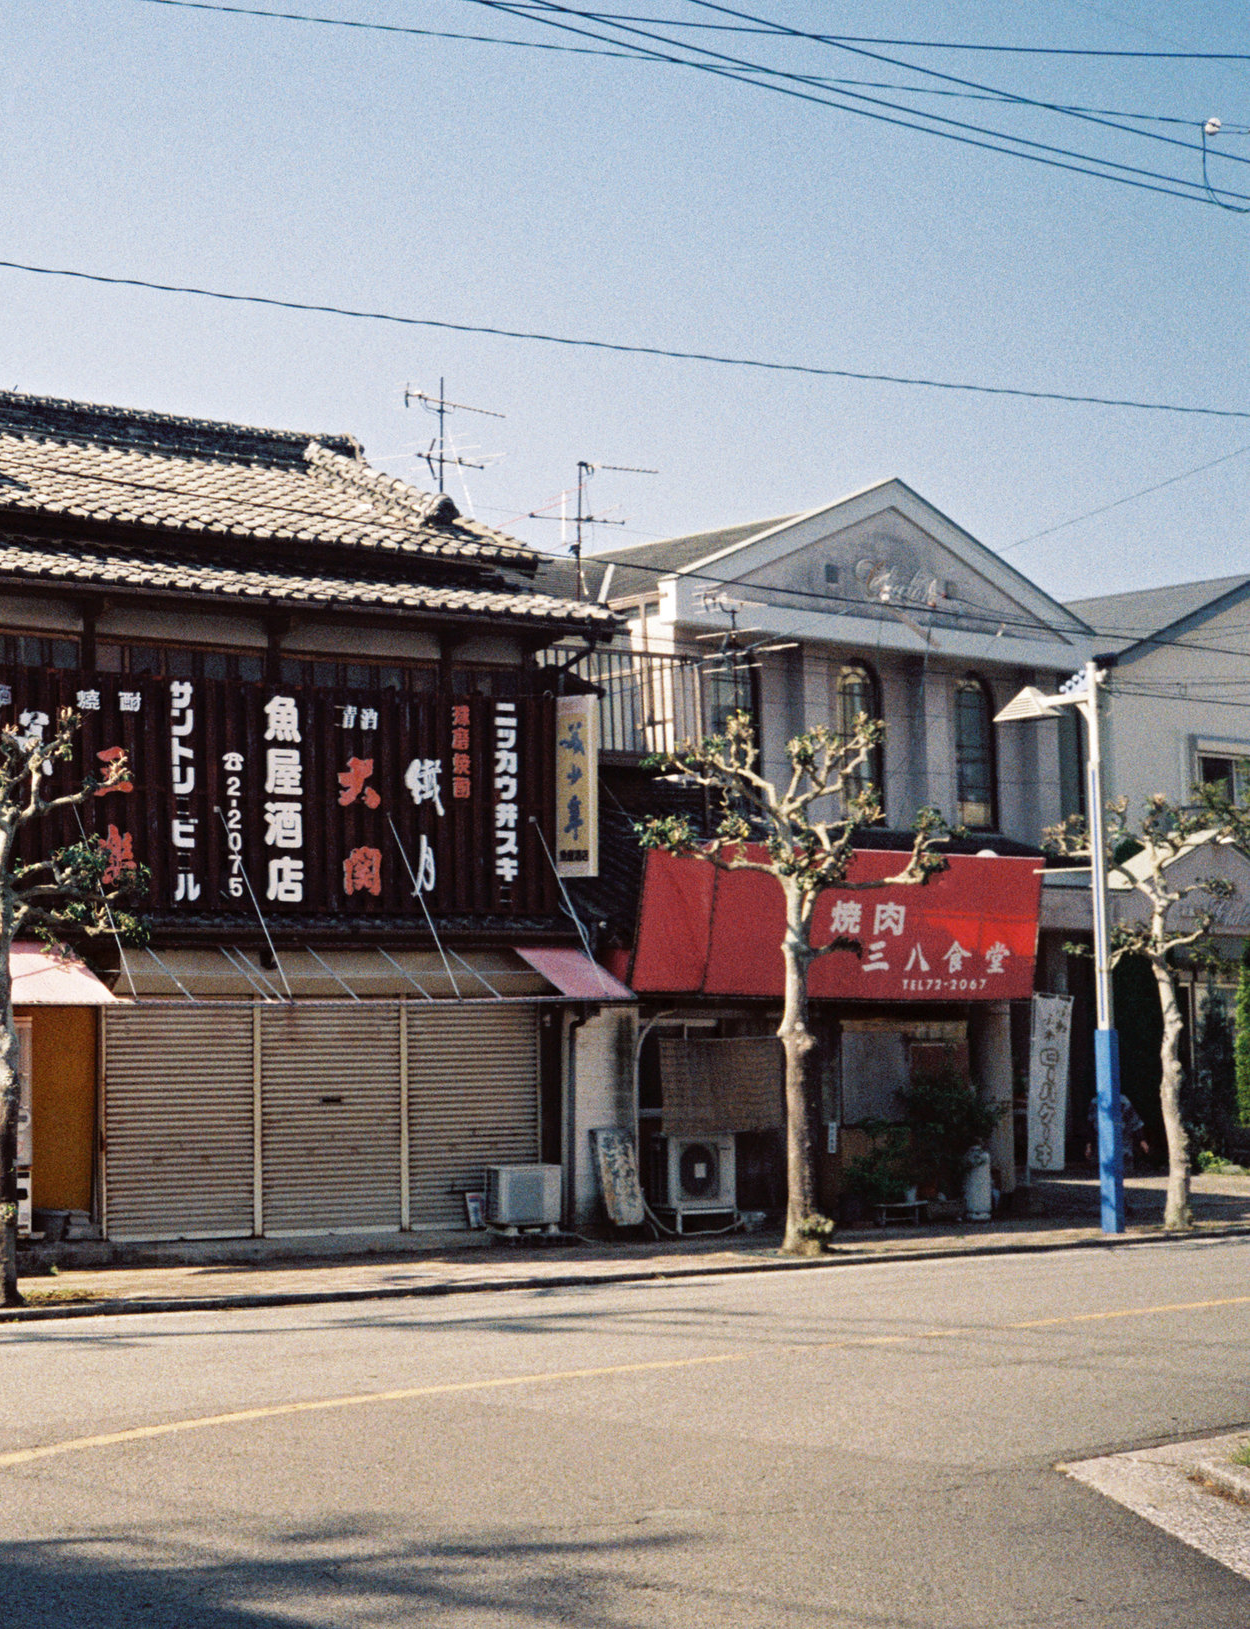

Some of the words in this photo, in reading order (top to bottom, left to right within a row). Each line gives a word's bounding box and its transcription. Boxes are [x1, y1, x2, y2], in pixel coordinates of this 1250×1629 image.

[76, 689, 141, 712] 焼酎
[226, 776, 244, 897] 2-2075
[264, 695, 303, 902] 魚屋酒店
[337, 757, 382, 896] 大関
[830, 899, 906, 936] 焼肉
[862, 940, 1011, 974] 三八食堂
